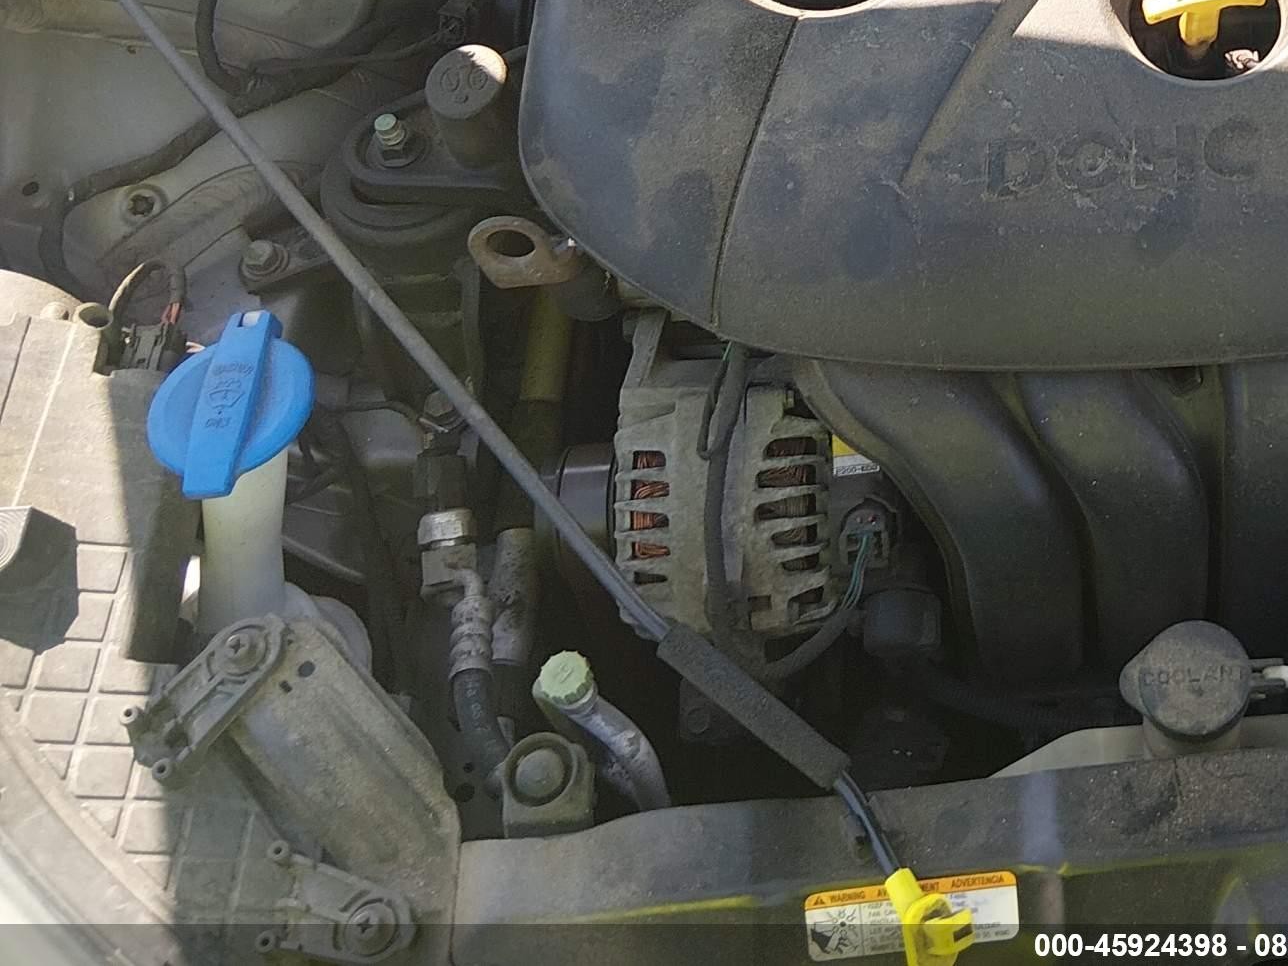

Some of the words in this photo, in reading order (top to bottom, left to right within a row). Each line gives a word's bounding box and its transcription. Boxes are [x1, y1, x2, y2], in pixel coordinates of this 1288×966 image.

[985, 115, 1262, 199] DOHC
[829, 891, 866, 903] WARNING
[951, 876, 1005, 889] ADVERTENCIA
